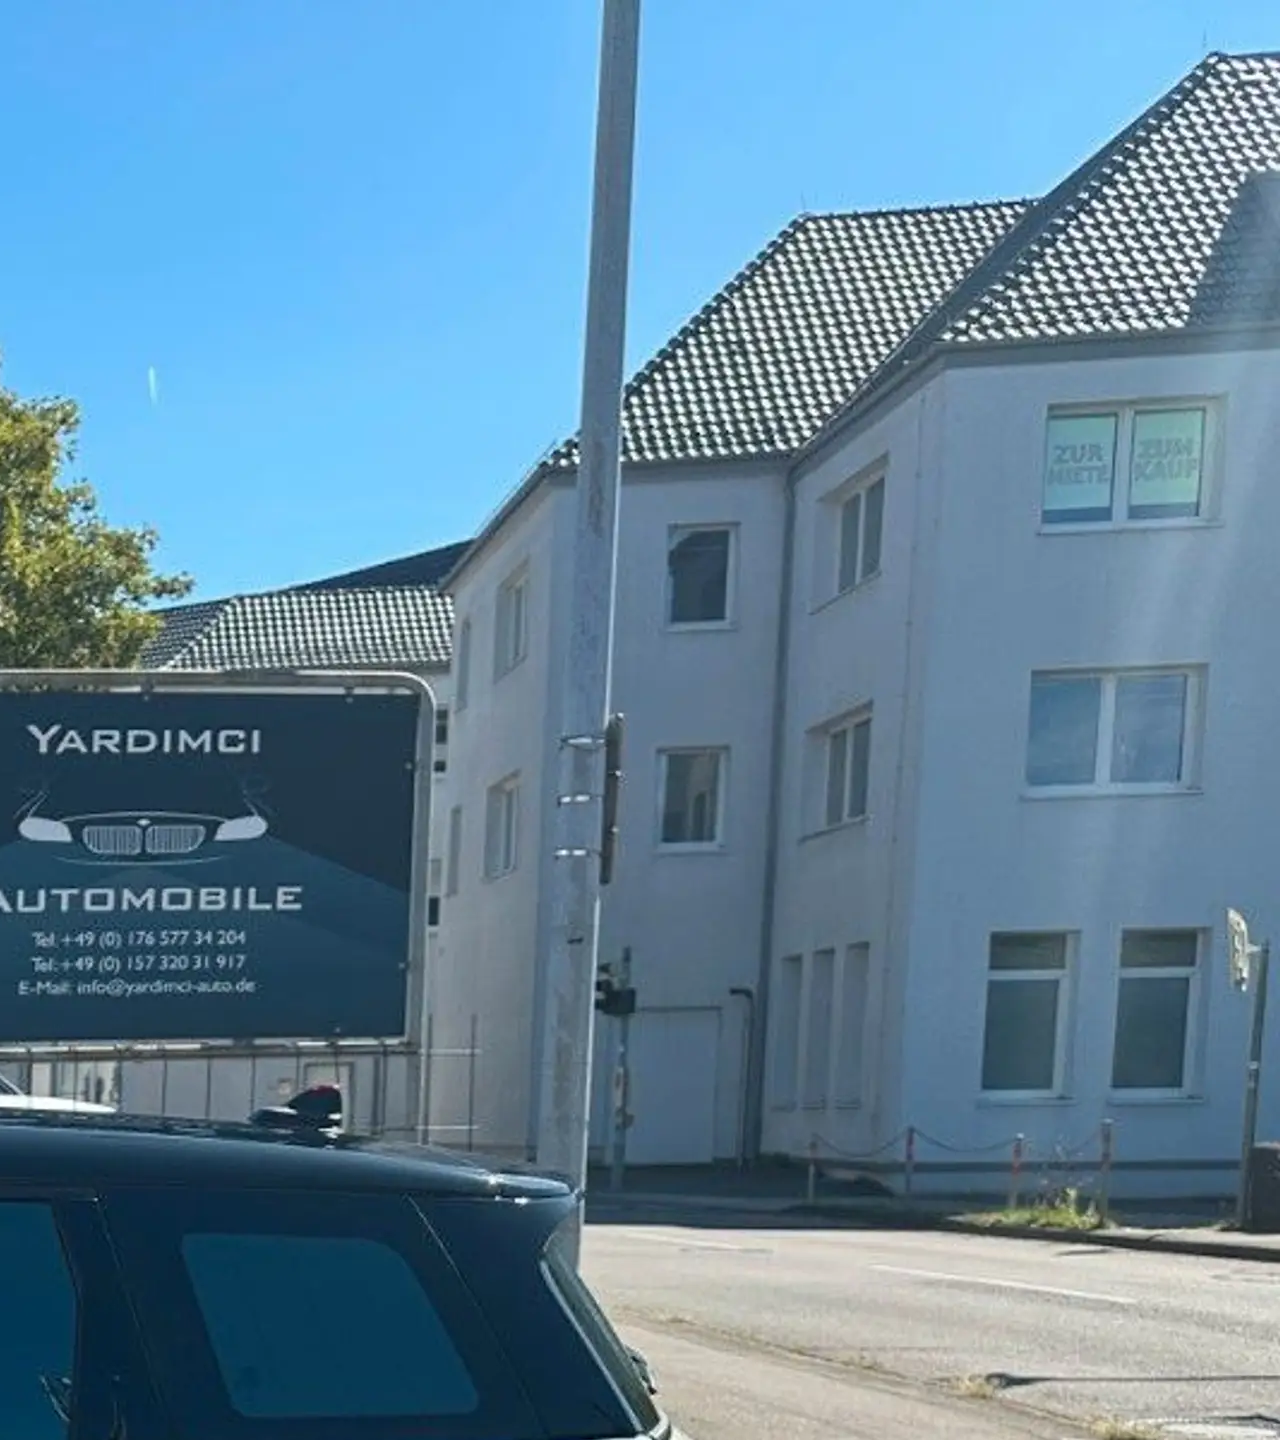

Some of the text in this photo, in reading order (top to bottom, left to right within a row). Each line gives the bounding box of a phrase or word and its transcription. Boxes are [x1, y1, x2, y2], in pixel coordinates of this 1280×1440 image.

[1052, 443, 1104, 464] ZUR
[26, 724, 263, 754] YARDIMCI
[61, 931, 96, 947] +49
[99, 931, 123, 949] (0)
[128, 931, 156, 945] 176
[159, 930, 189, 945] 577
[193, 930, 212, 944] 34
[217, 930, 247, 945] 204
[62, 956, 95, 972] +49
[98, 957, 121, 974] (0)
[127, 956, 155, 971] 157
[159, 955, 189, 971] 320
[193, 955, 210, 970] 31
[216, 954, 247, 970] 917
[77, 977, 257, 998] info@yardimci-auto.de
